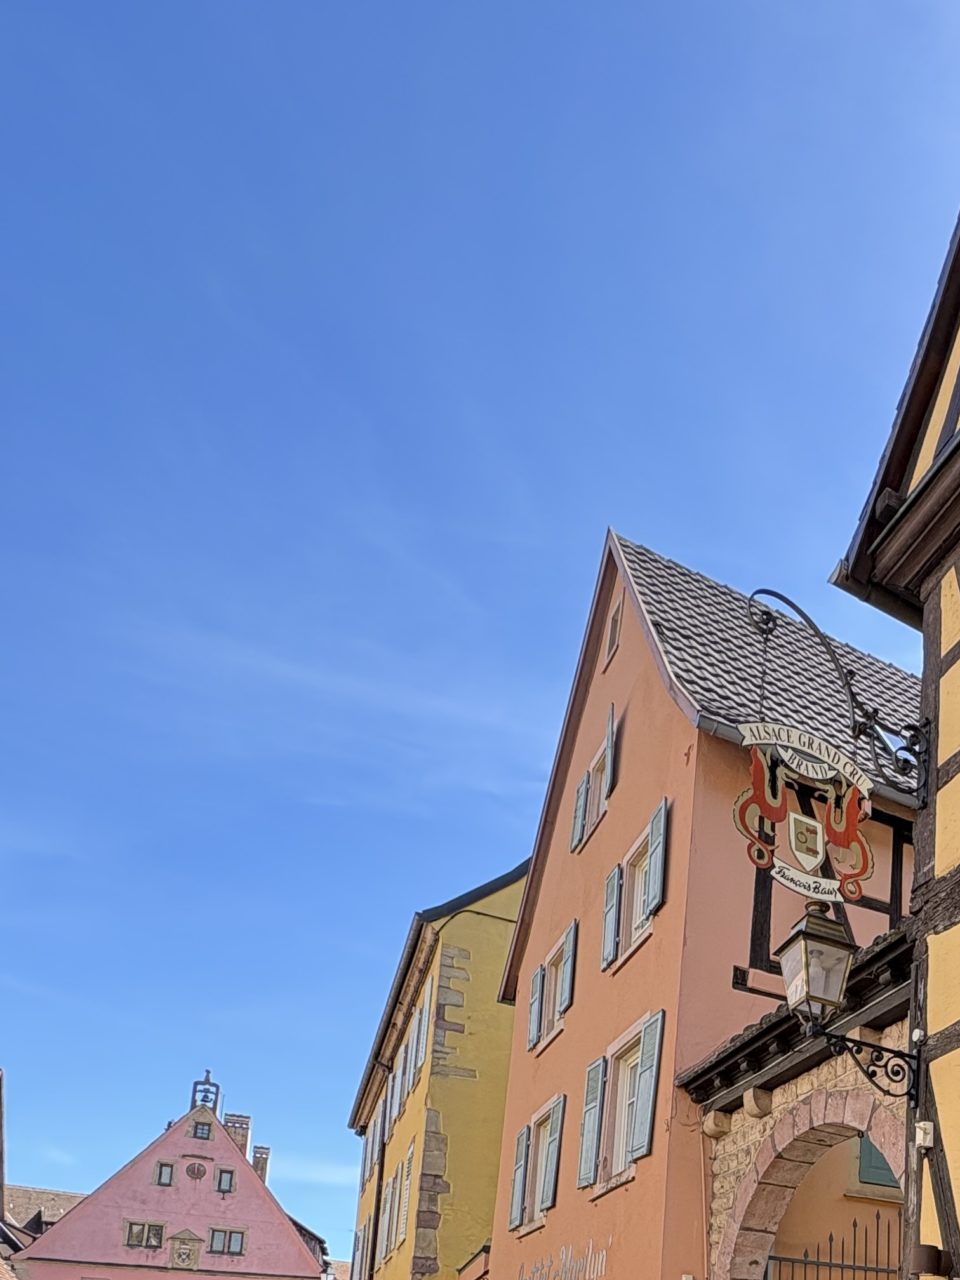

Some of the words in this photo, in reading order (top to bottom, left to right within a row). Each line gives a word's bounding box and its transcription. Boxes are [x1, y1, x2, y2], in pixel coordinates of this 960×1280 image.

[749, 724, 794, 744] ALSACE
[798, 732, 841, 765] GRAND
[842, 761, 868, 787] CRU
[787, 752, 829, 778] BRAND
